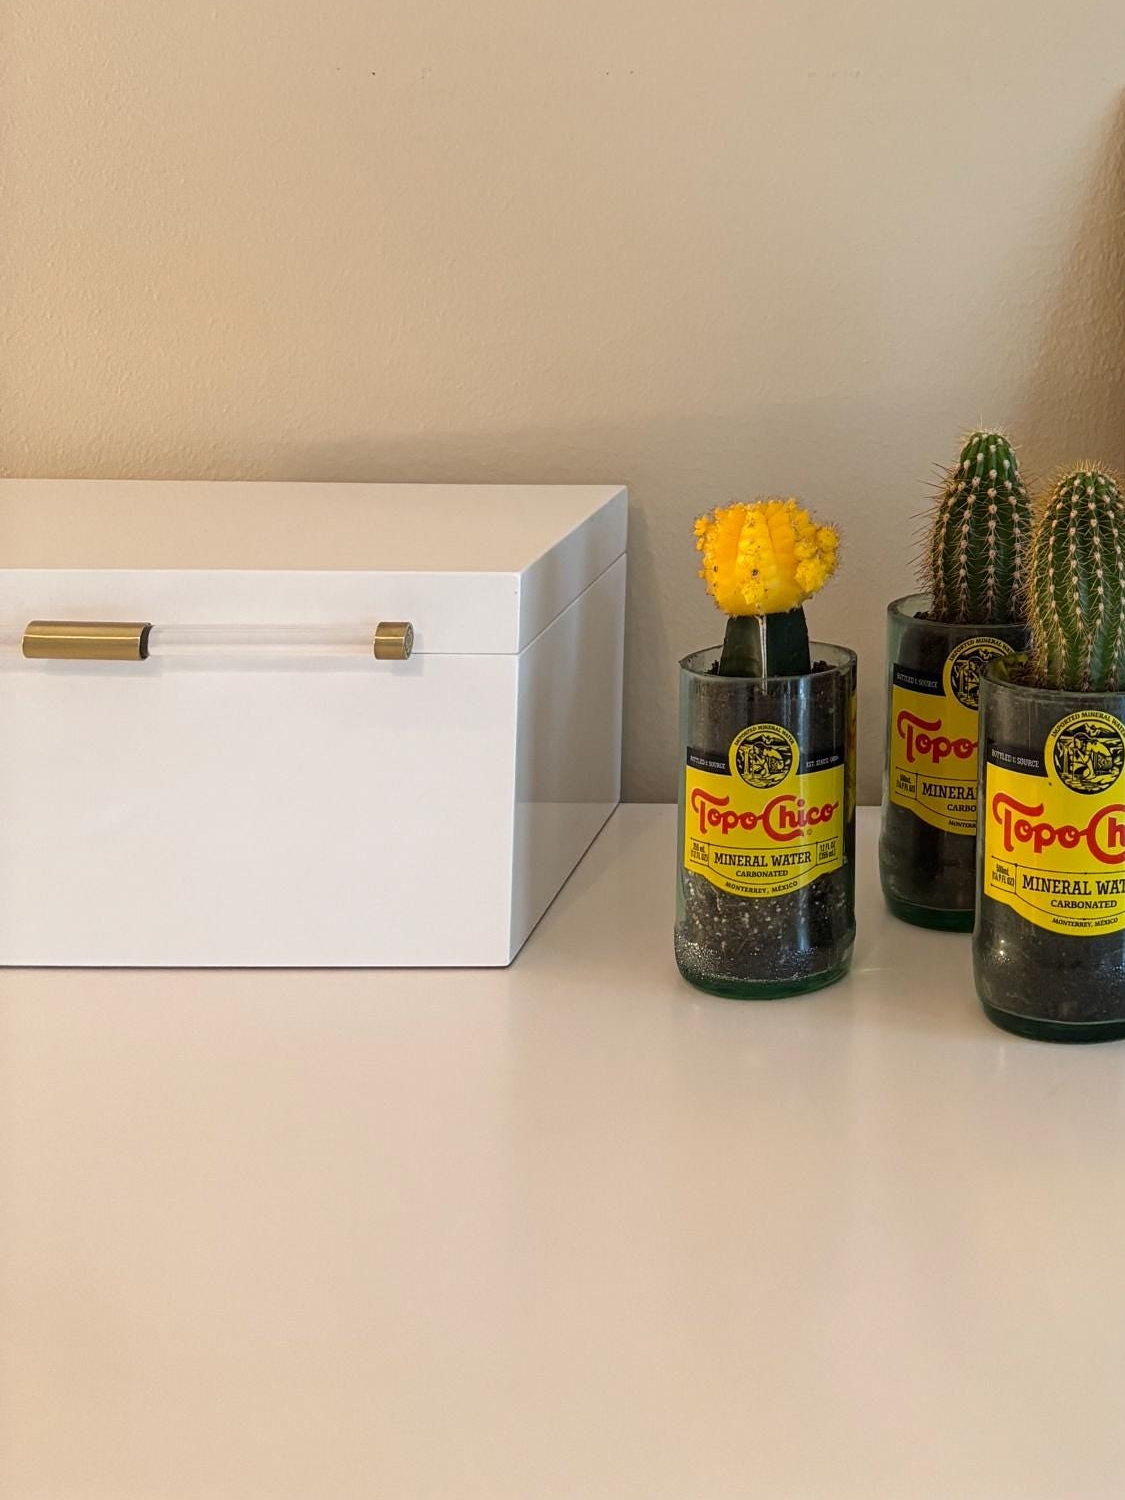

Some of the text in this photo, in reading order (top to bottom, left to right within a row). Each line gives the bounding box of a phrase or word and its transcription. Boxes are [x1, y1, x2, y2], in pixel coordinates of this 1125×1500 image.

[1051, 713, 1081, 738] IMPORTED
[1081, 711, 1112, 722] MINERAL
[897, 710, 978, 764] Topo
[991, 748, 1012, 763] BOTTLED
[1016, 756, 1040, 768] SOURCE
[922, 782, 977, 800] MINERA
[691, 788, 839, 842] Topo Chico
[947, 804, 976, 812] CARBO
[992, 792, 1084, 854] Topo
[714, 851, 812, 867] MINERAL WATER
[736, 870, 789, 878] CARBONATED
[1022, 874, 1092, 895] MINERAL
[1050, 899, 1117, 909] CARBONATED
[1051, 917, 1093, 928] MONTERREY,
